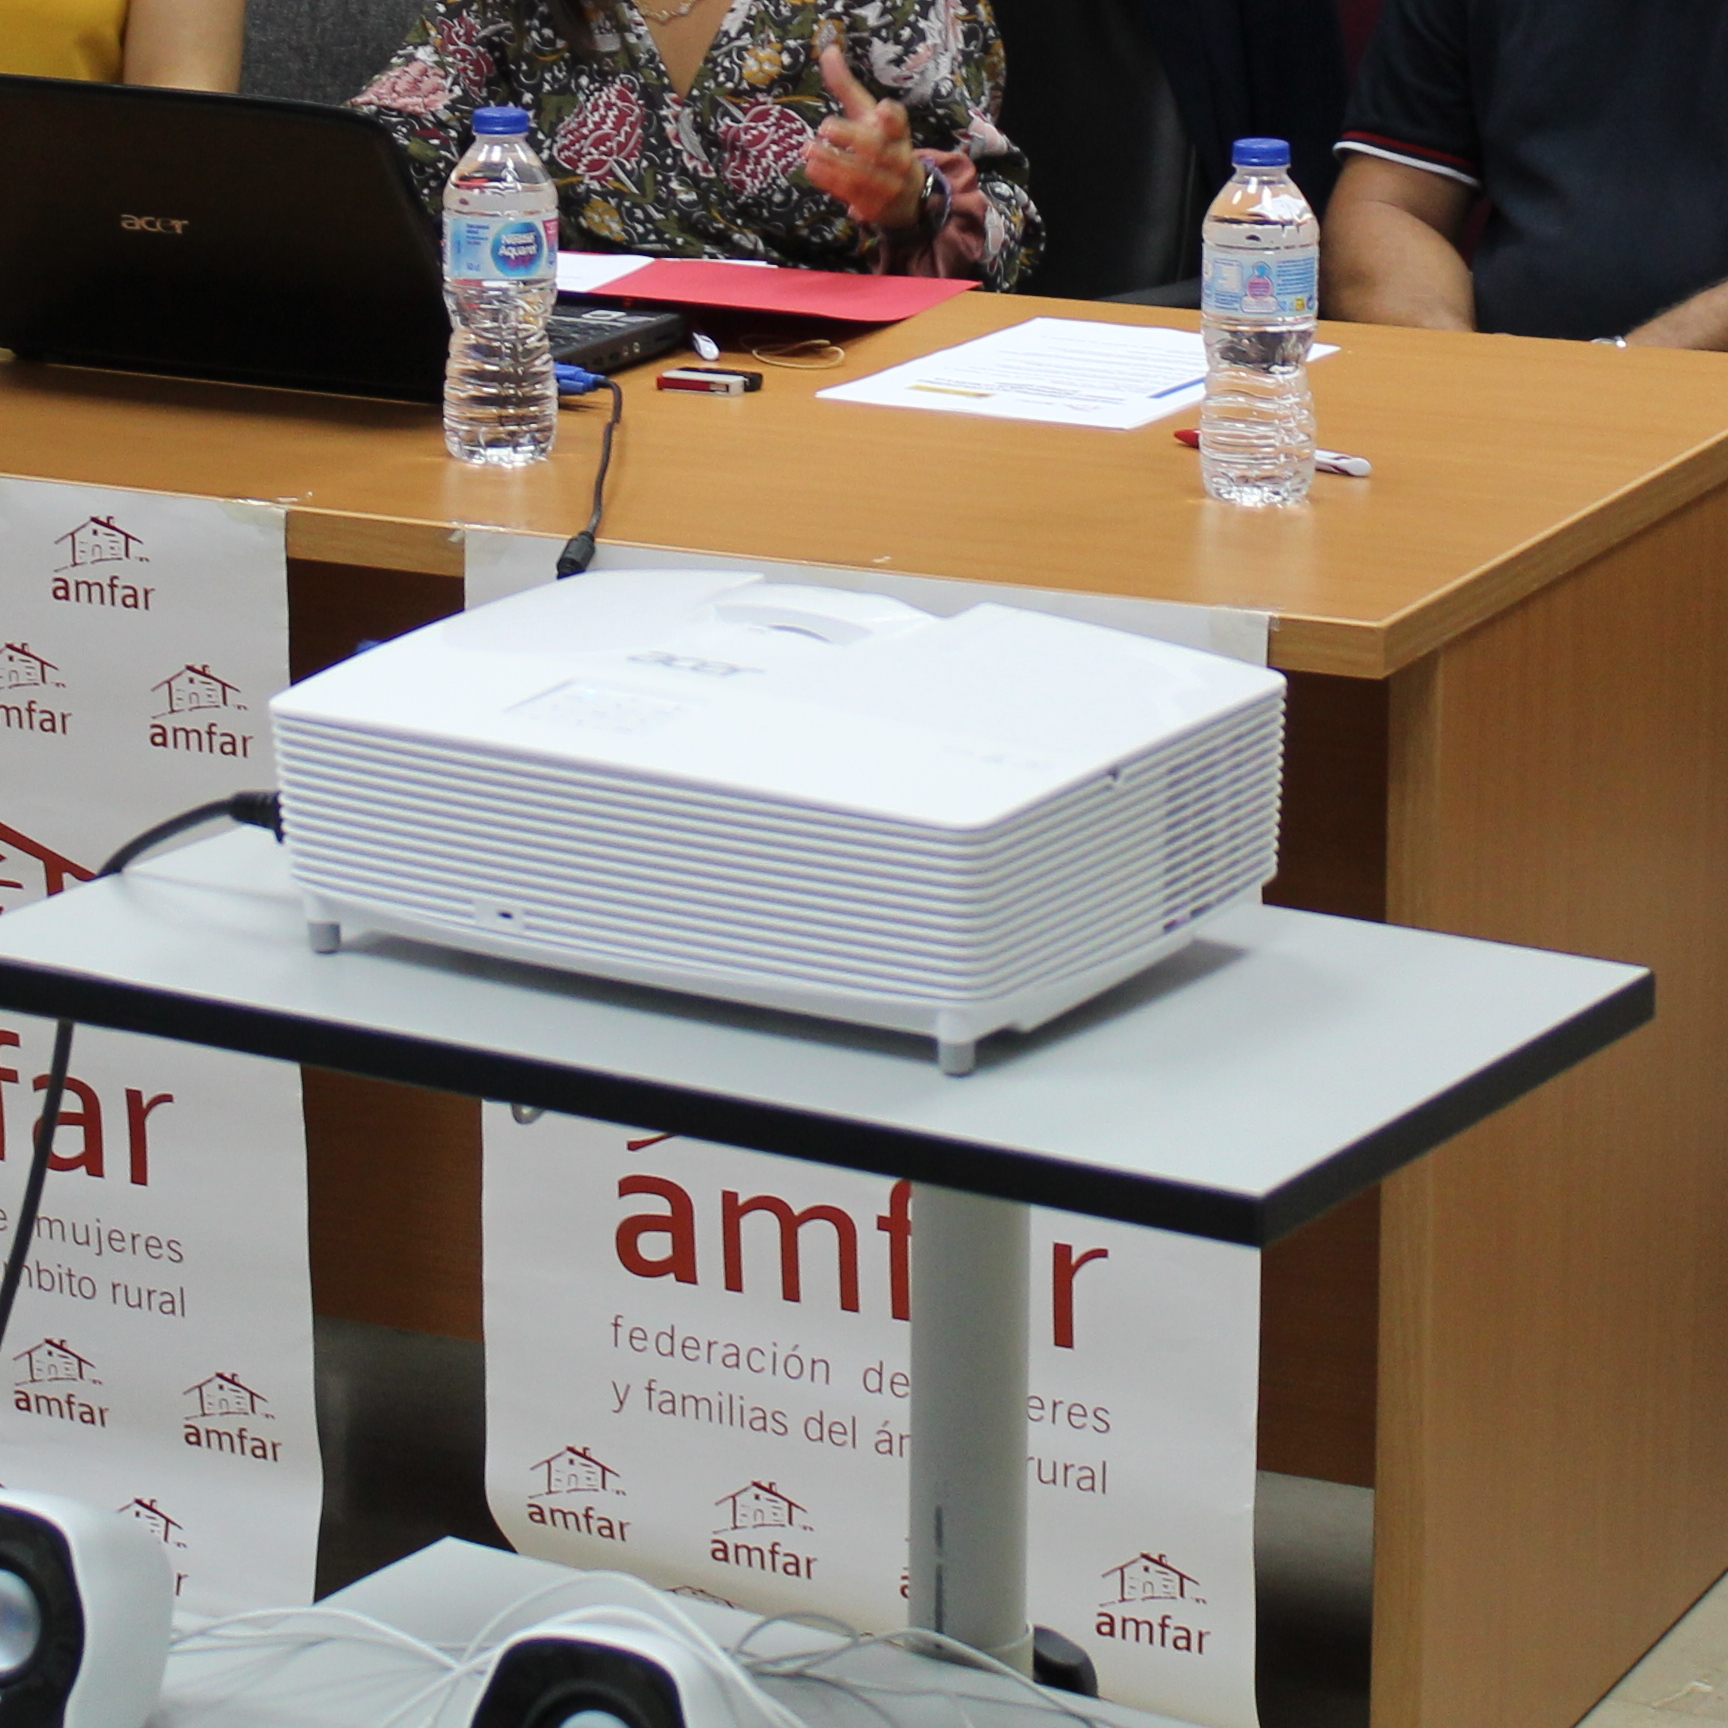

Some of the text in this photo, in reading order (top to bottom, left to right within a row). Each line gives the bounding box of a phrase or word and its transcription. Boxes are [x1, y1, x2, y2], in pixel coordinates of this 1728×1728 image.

[121, 214, 189, 234] acer
[52, 576, 154, 610] amfar
[150, 723, 252, 757] amfar
[36, 1215, 183, 1263] mujeres
[615, 1173, 1108, 1350] amfr
[112, 1282, 185, 1317] rural
[611, 1315, 1111, 1434] federación de eres
[14, 1390, 108, 1427] amfar
[612, 1381, 630, 1413] y
[645, 1379, 788, 1436] familias
[804, 1410, 856, 1449] del
[184, 1424, 281, 1462] amfar
[527, 1503, 629, 1542] amfar
[711, 1539, 816, 1579] amfar
[1096, 1612, 1209, 1654] amfar
